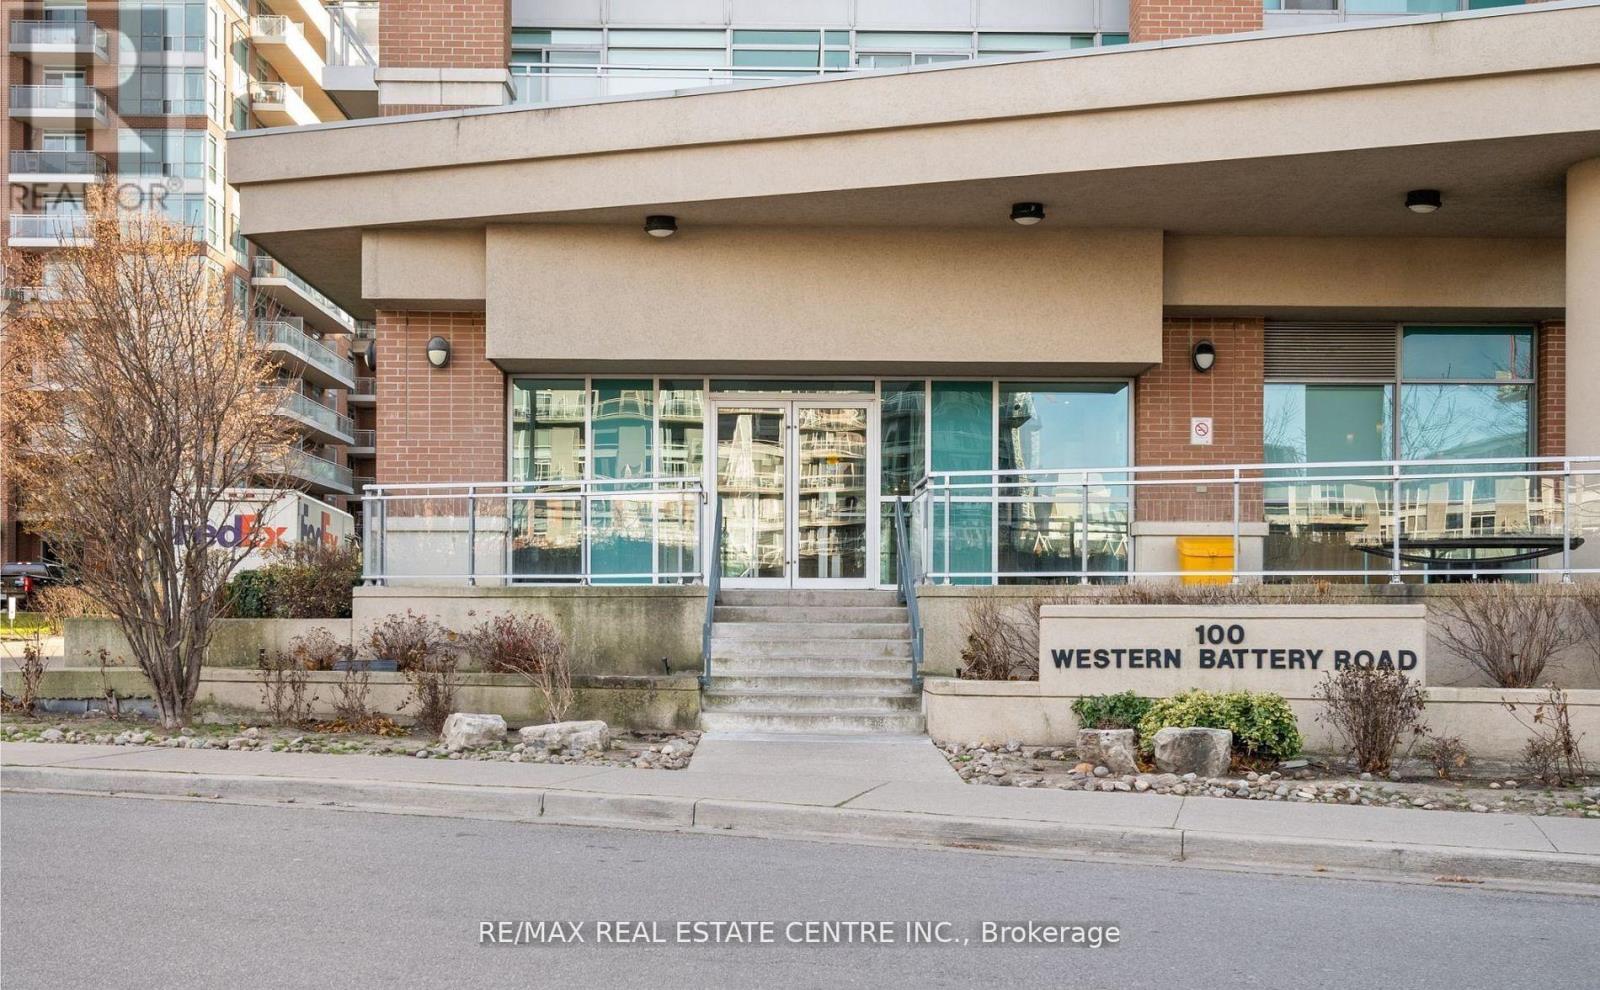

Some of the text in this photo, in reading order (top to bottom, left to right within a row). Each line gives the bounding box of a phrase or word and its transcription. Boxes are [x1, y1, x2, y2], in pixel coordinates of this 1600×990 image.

[1195, 624, 1245, 645] 100
[1051, 648, 1418, 671] WESTERN BATTERY ROAD
